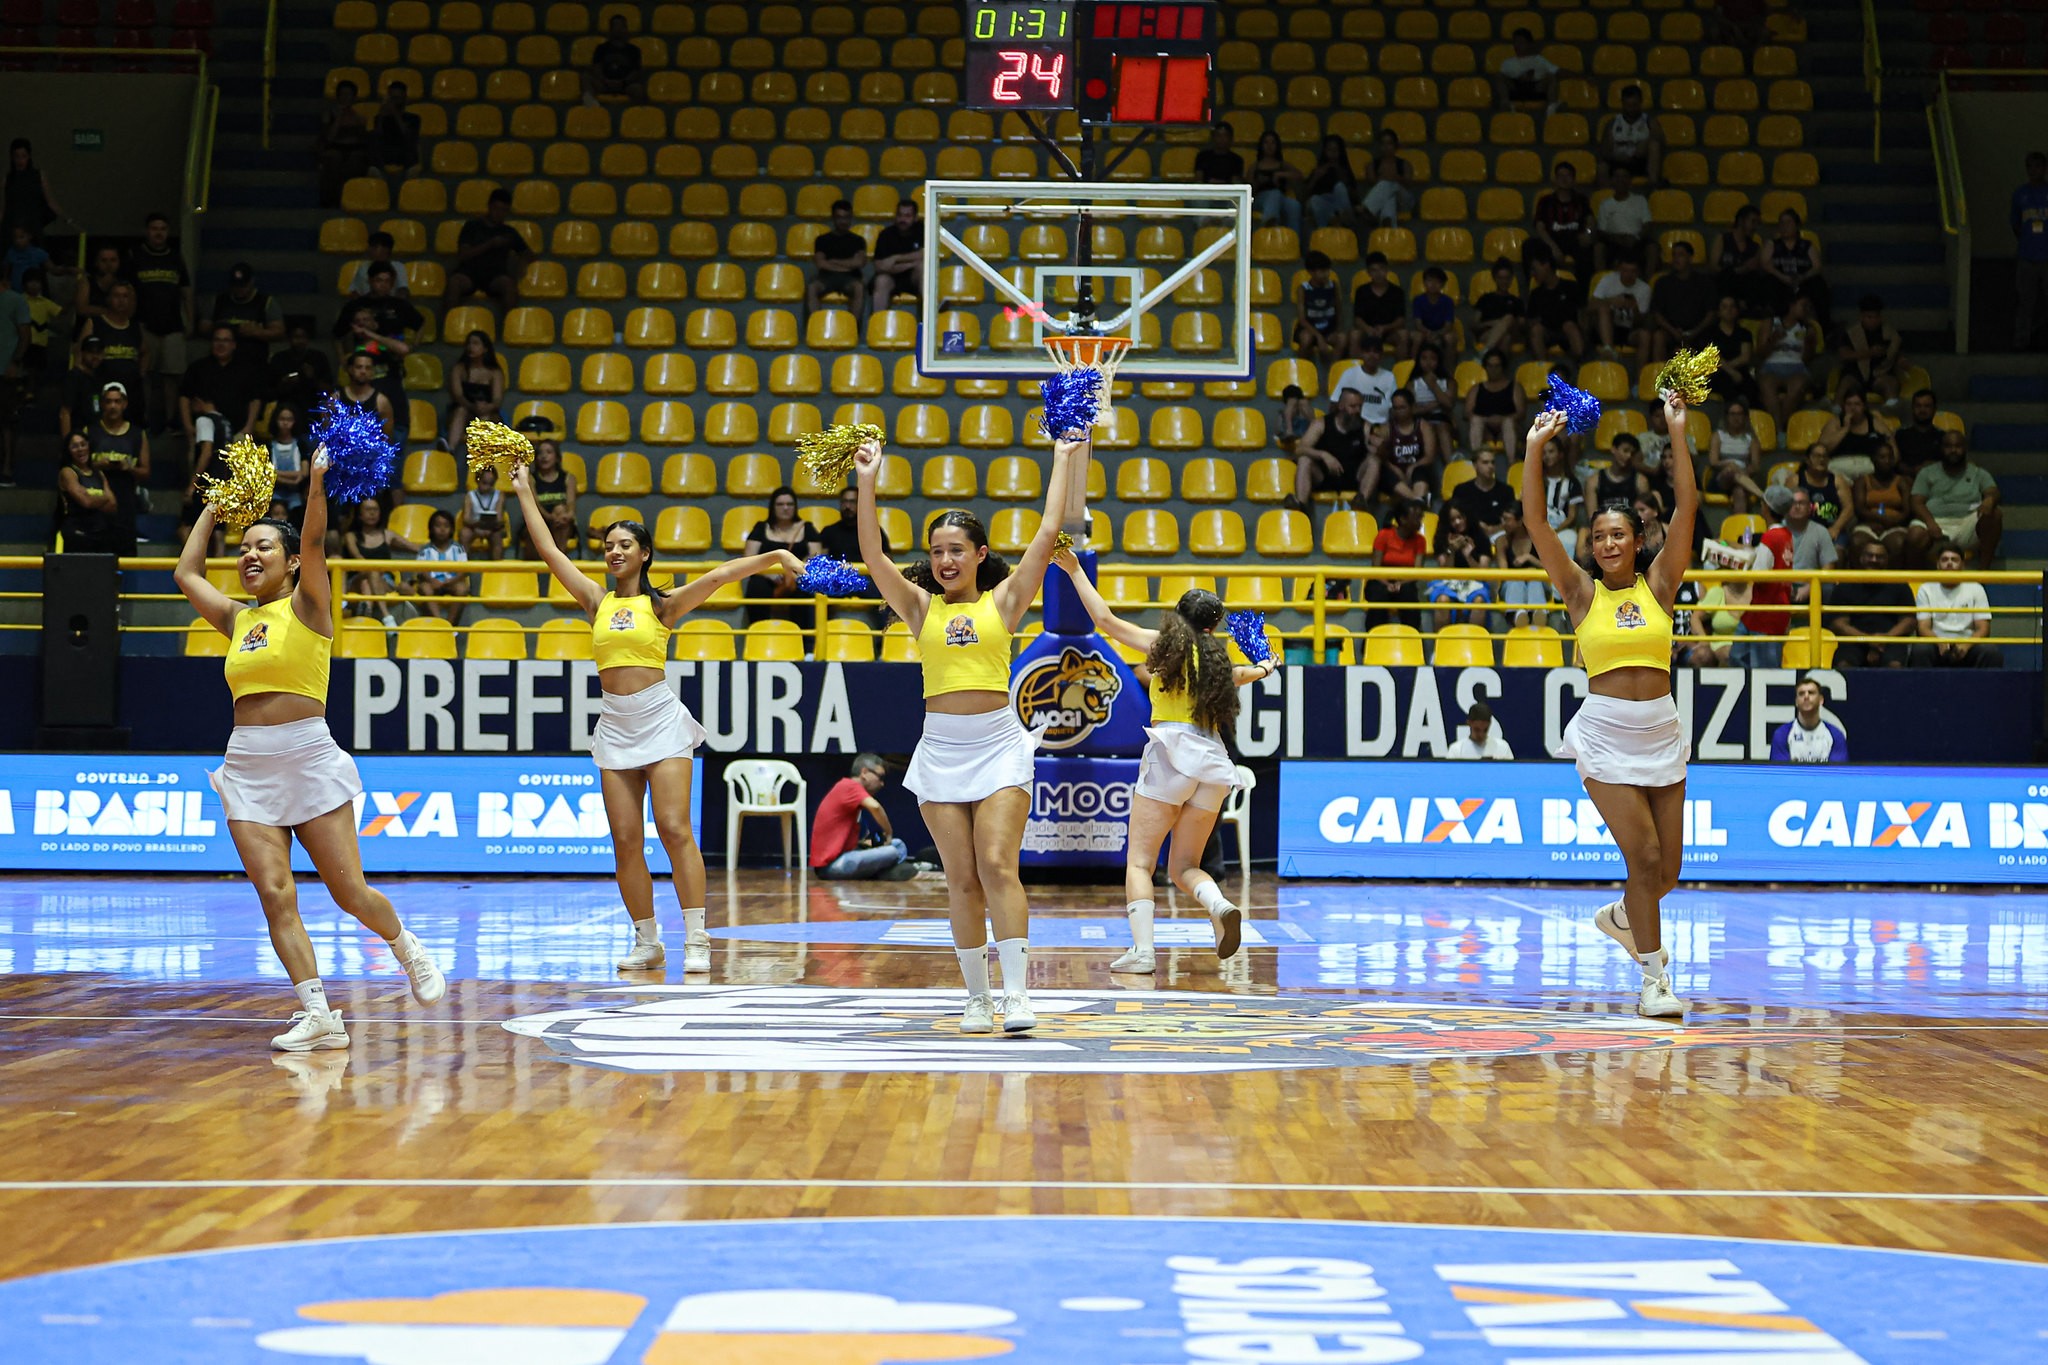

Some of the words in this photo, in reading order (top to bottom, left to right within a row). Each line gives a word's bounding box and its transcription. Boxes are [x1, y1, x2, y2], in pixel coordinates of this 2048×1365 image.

[974, 9, 1068, 39] 01:31
[992, 51, 1064, 101] 24
[353, 658, 858, 754] PREFEURA
[1029, 709, 1082, 728] MOGI
[75, 772, 149, 784] GOVERNO
[157, 773, 179, 784] DO
[518, 774, 594, 786] GOVERNO
[33, 789, 216, 837] BRASIL
[477, 791, 660, 838] BRAS
[1025, 820, 1055, 833] dade
[1318, 795, 1524, 845] CAIXA
[1541, 798, 1728, 846] BRIL
[1767, 799, 1972, 849] CAIXA
[1989, 802, 2048, 849] BR
[41, 842, 57, 852] DO
[60, 842, 90, 852] LADO
[92, 843, 107, 852] DO
[111, 843, 142, 852] POVO
[144, 843, 206, 853] BRASILEIRO
[486, 845, 502, 855] DO
[505, 845, 535, 855] LADO
[538, 845, 554, 855] DO
[558, 845, 588, 855] POVO
[1551, 851, 1567, 862] DO
[1571, 852, 1600, 862] LADO
[1604, 852, 1621, 862] DO
[1999, 855, 2015, 865] DO
